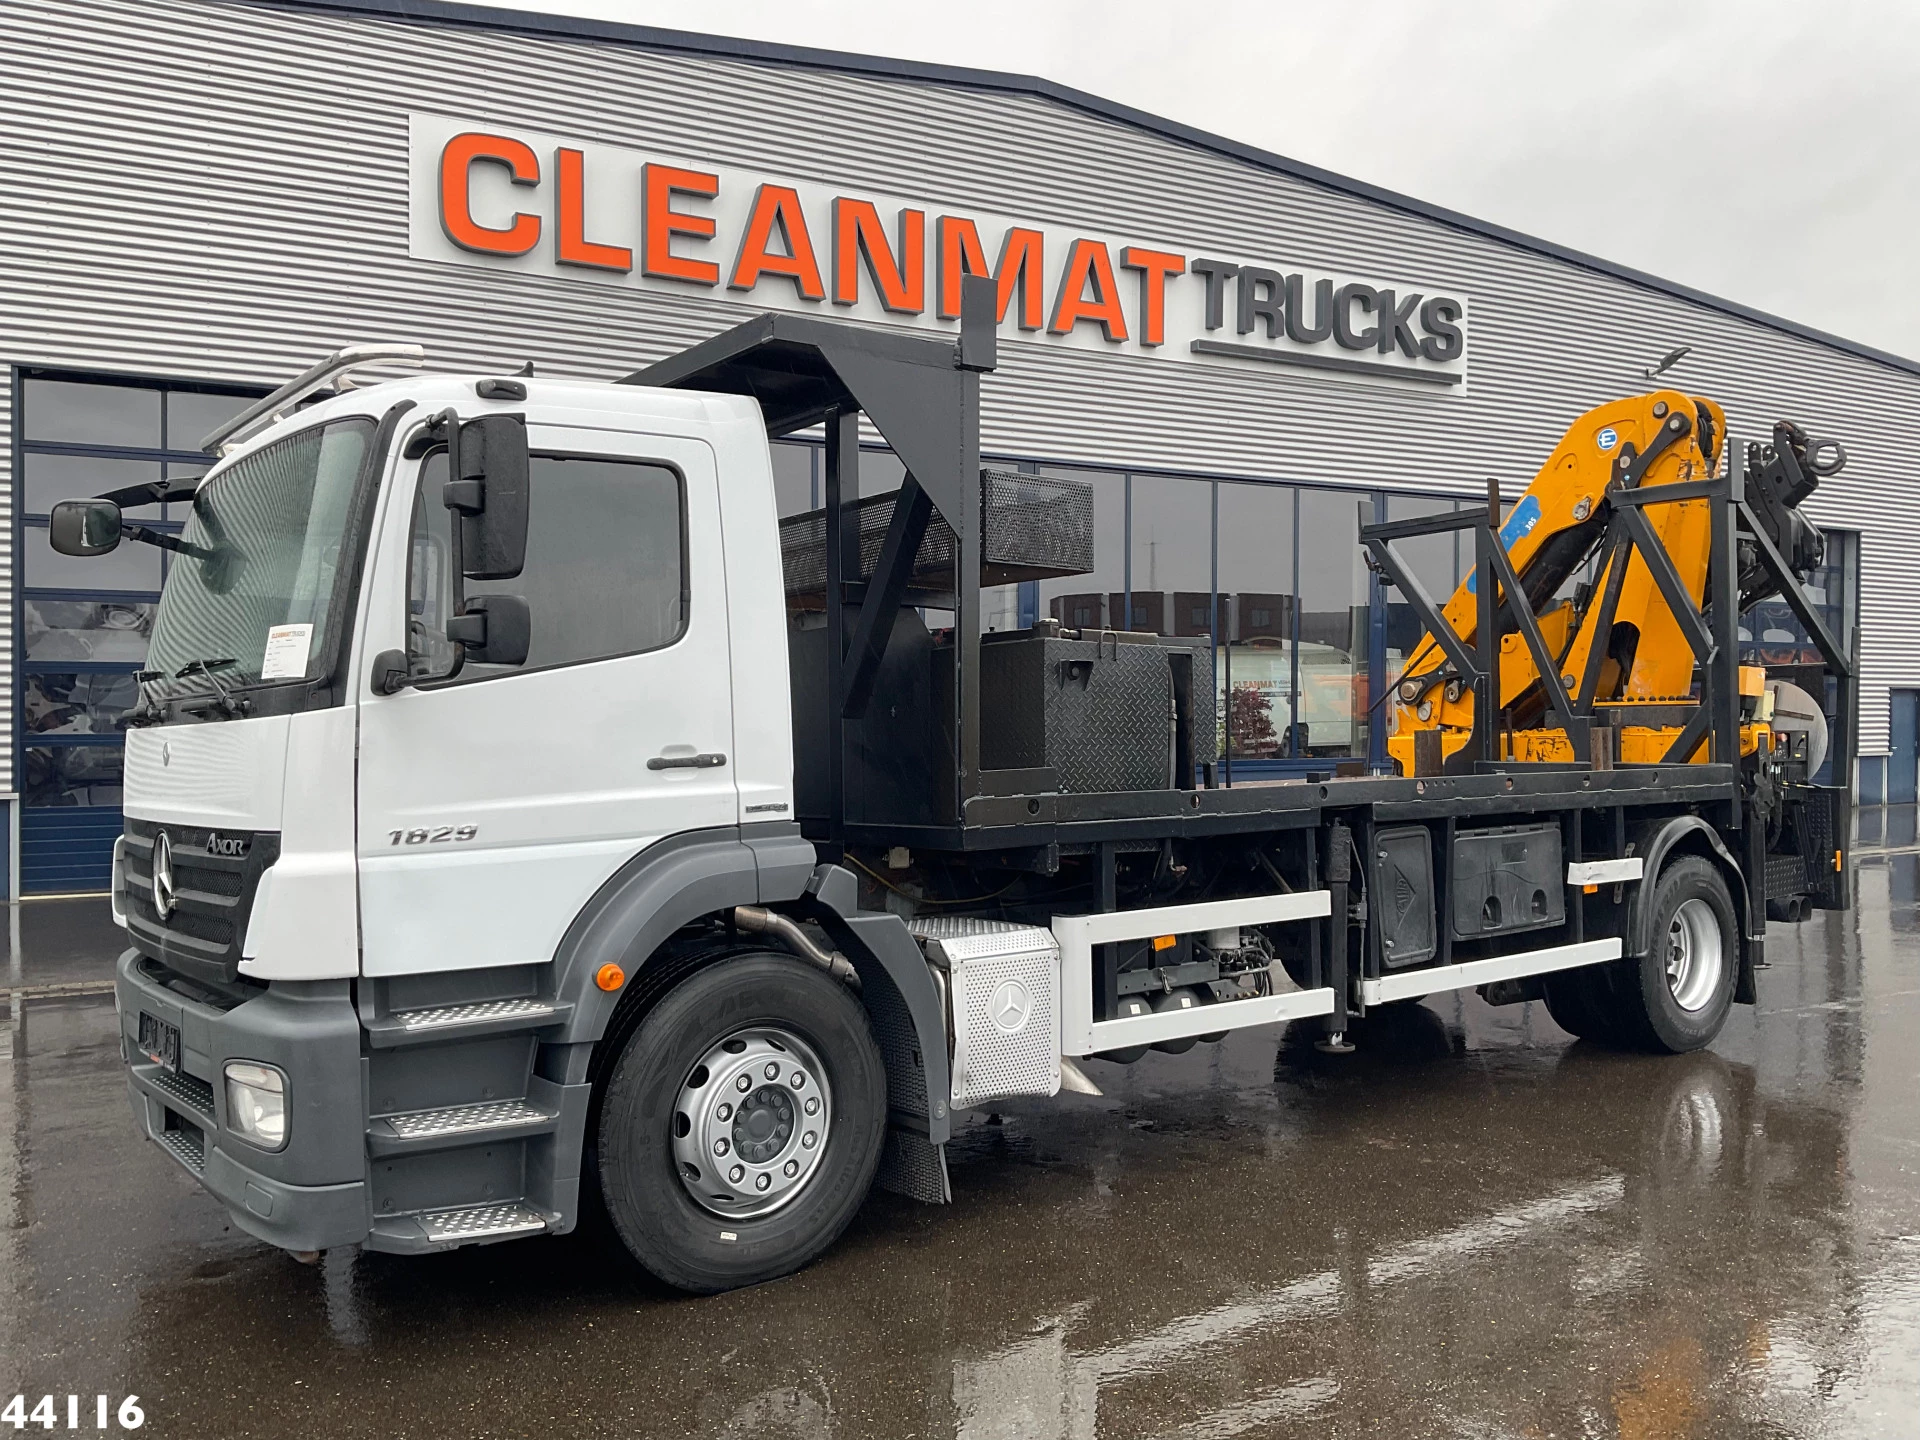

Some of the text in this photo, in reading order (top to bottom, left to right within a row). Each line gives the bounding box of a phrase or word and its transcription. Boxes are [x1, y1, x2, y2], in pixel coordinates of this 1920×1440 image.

[438, 131, 1463, 361] CLEANMAT TRUCKS
[1525, 516, 1537, 531] 305
[1232, 680, 1277, 689] CLEANMAT
[388, 823, 478, 846] 1829
